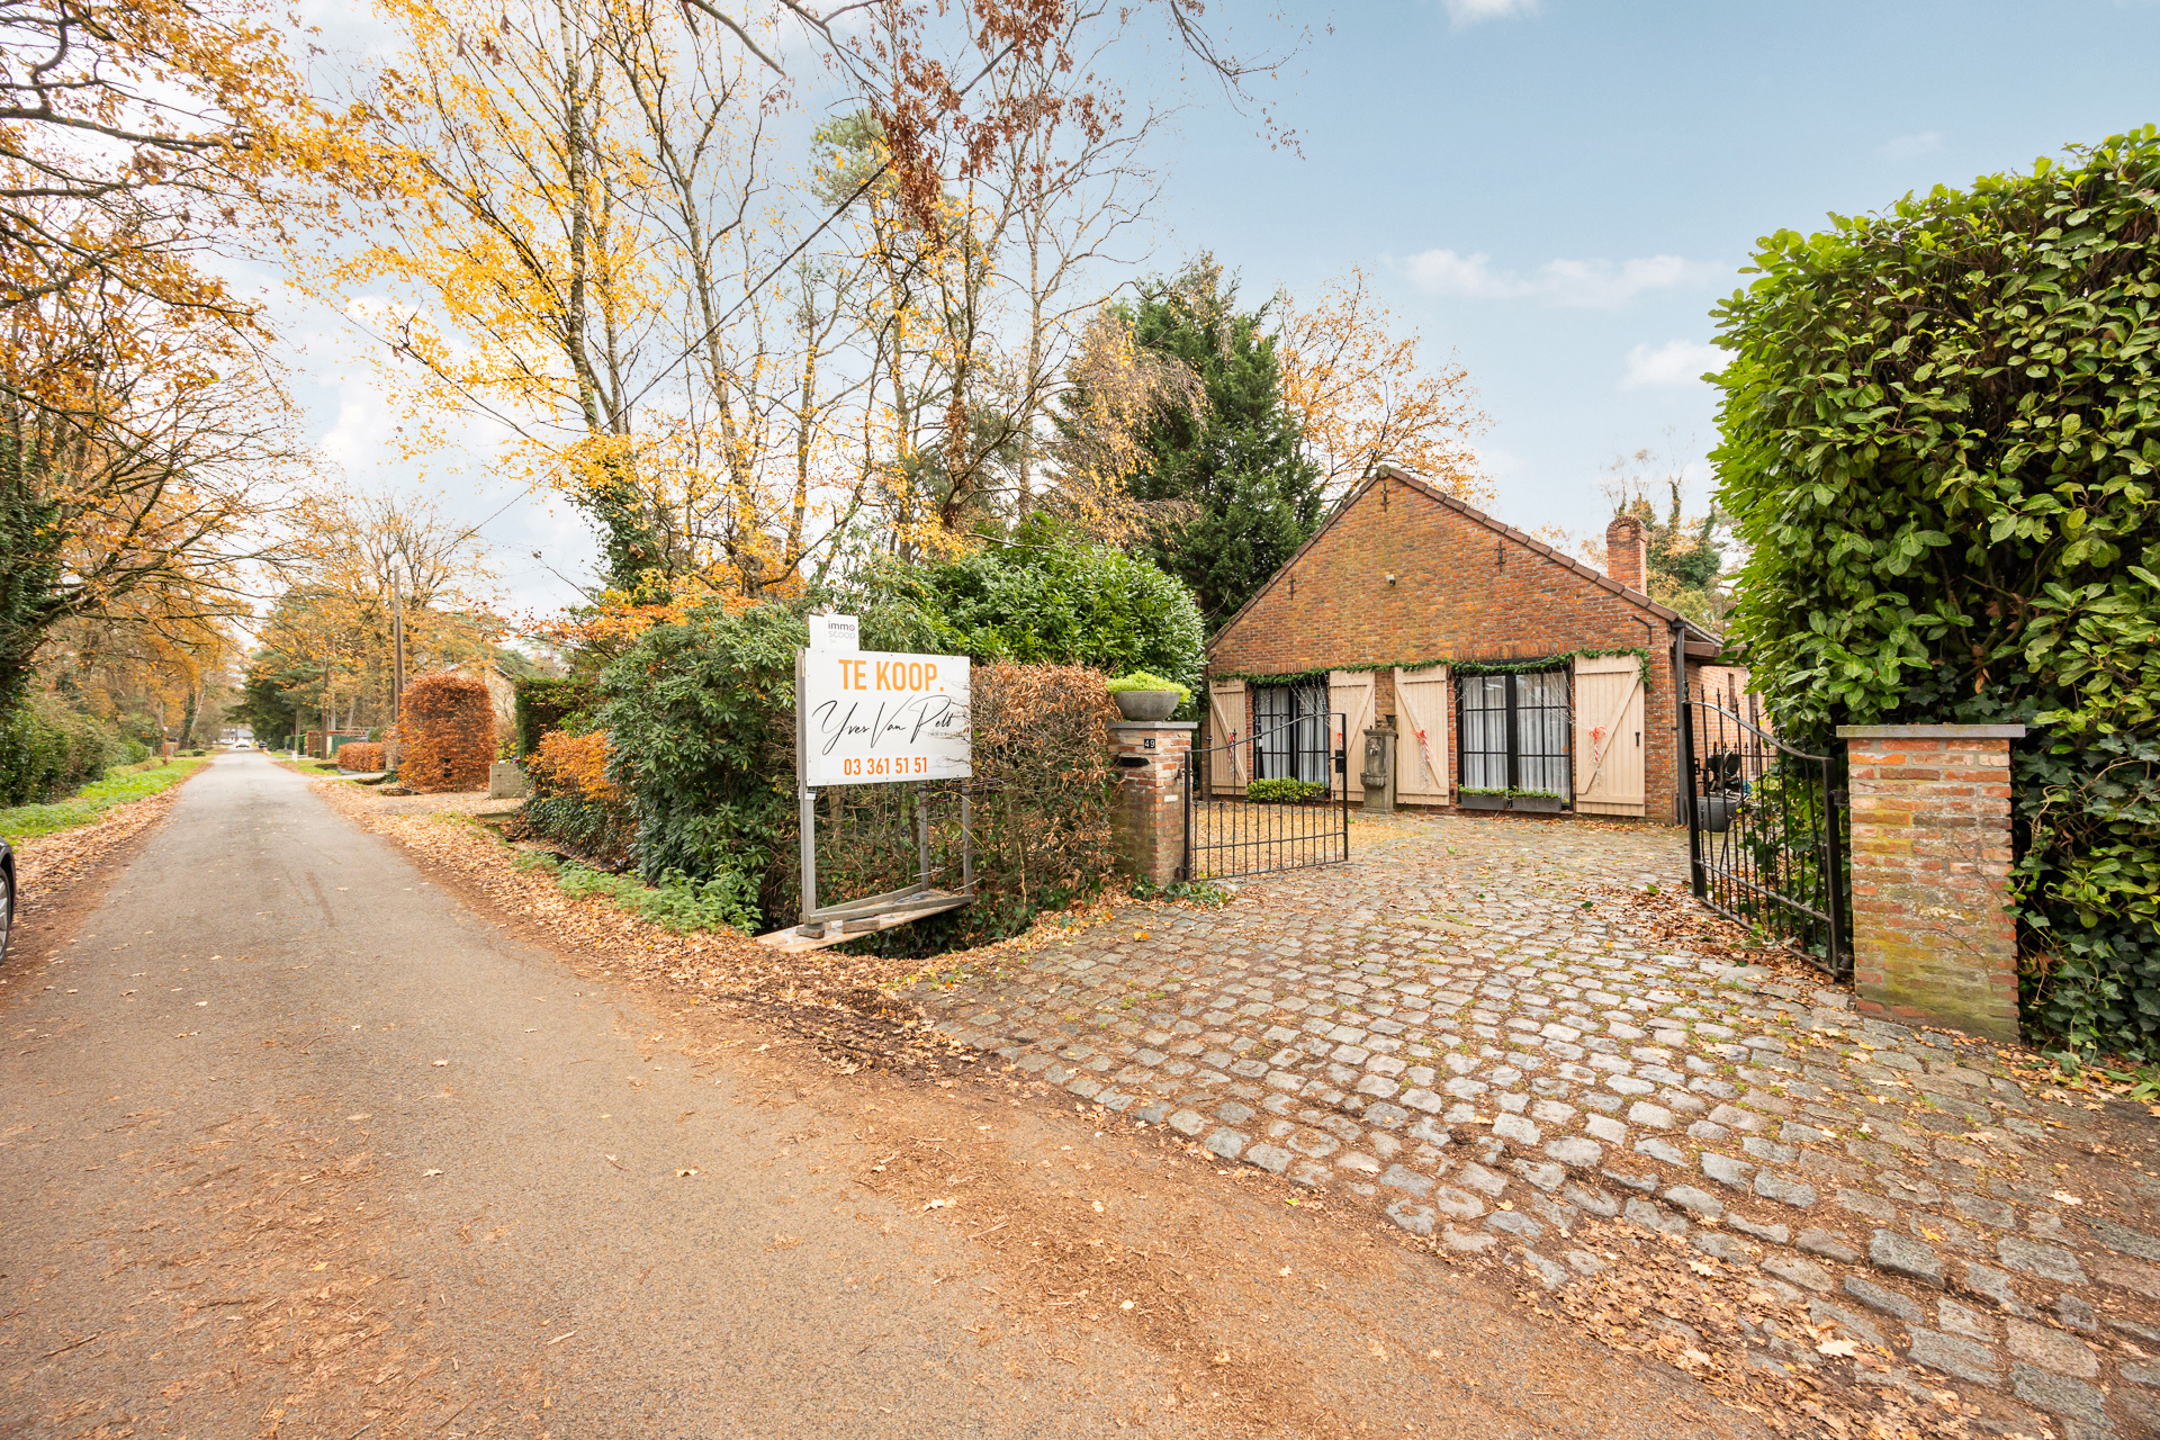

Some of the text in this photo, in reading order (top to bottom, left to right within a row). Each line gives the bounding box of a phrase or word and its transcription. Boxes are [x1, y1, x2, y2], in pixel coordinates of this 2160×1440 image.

[828, 620, 856, 631] immo
[828, 631, 856, 640] scoop
[838, 659, 944, 692] TE KOOP.
[812, 694, 954, 756] Yves Van Pelt
[1144, 739, 1155, 748] 49
[844, 756, 928, 776] 03 361 51 51
